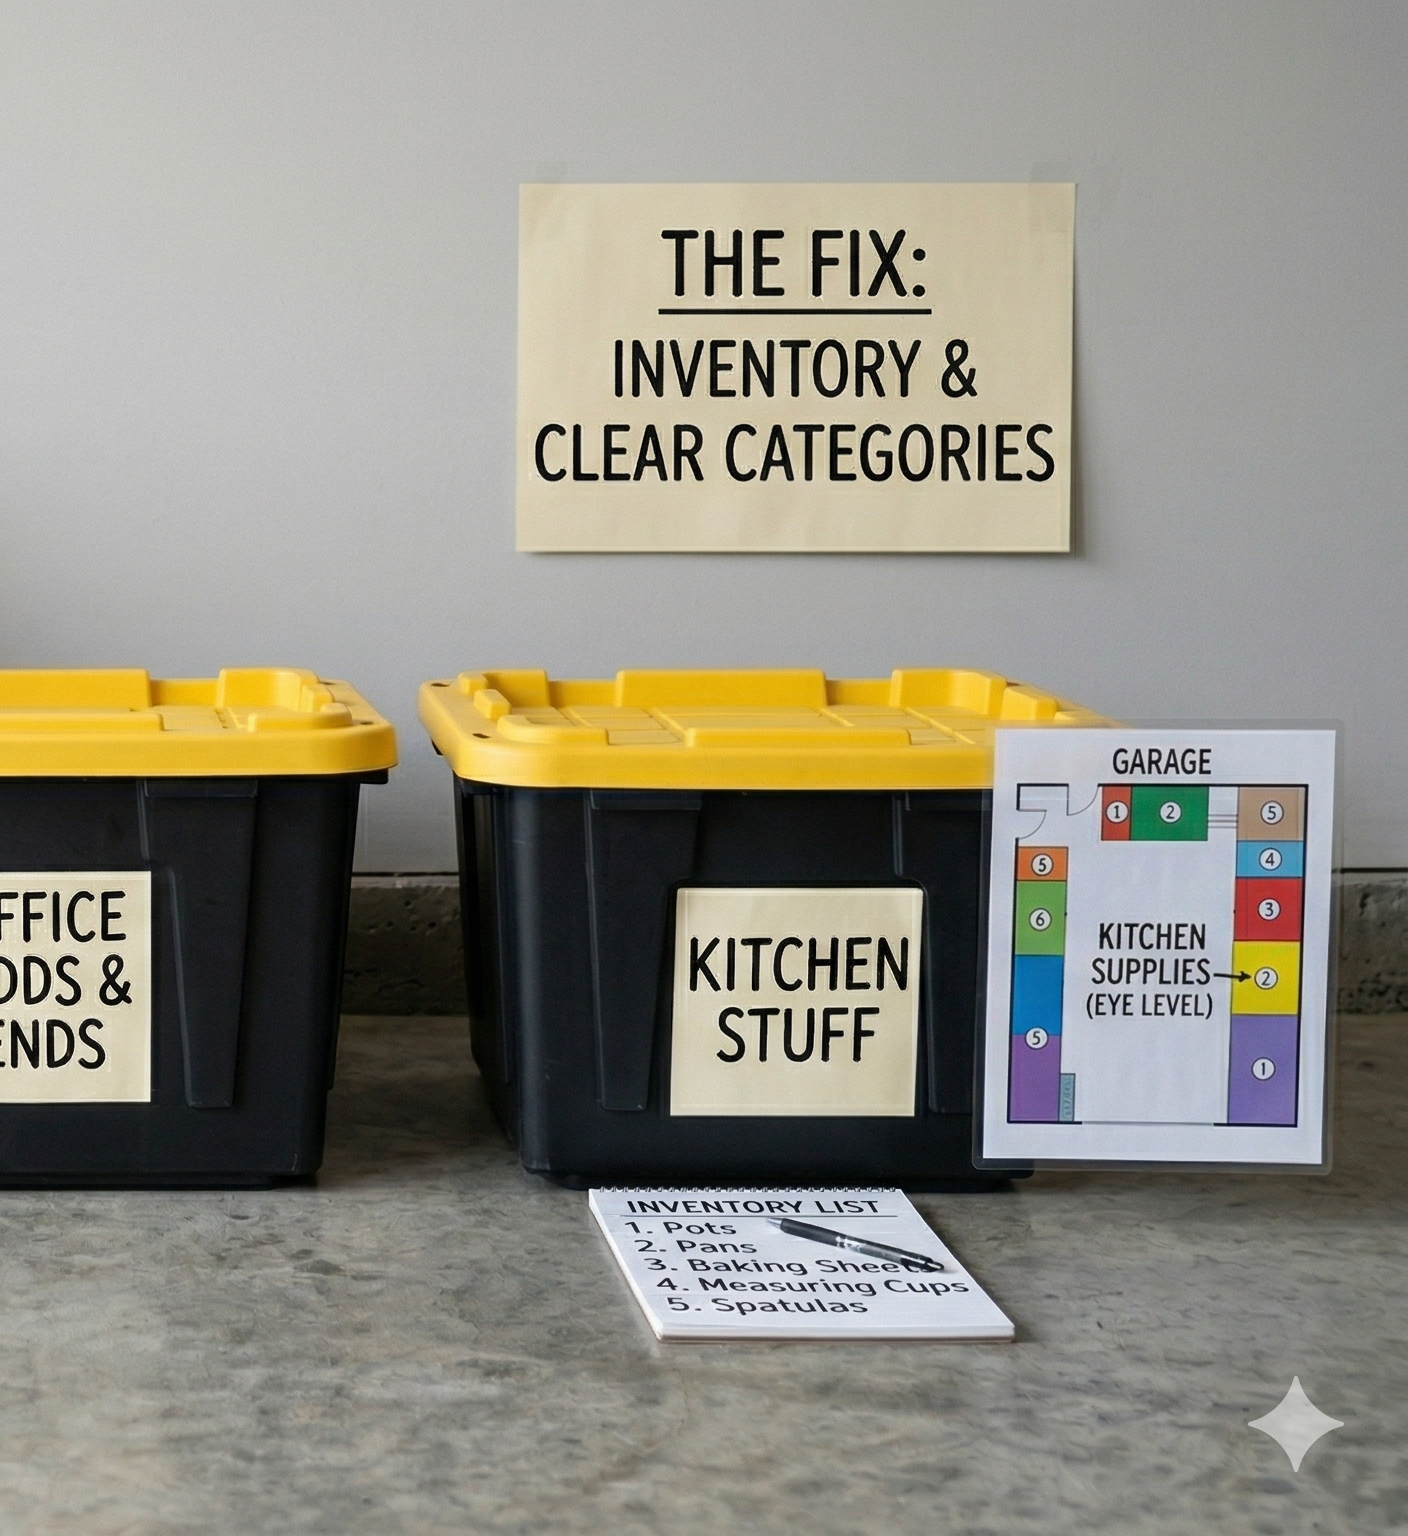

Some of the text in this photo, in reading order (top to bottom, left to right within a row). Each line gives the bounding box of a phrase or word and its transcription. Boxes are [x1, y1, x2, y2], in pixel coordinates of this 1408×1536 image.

[660, 229, 926, 298] THE FIX:
[614, 338, 978, 399] INVENTORY &
[534, 423, 1055, 483] CLEAR CATEGORIES
[1112, 747, 1212, 775] GARAGE
[1112, 803, 1122, 820] 1
[1164, 803, 1176, 821] 2
[1266, 804, 1278, 822] 5
[1037, 856, 1048, 874] 5
[1264, 851, 1276, 868] 4
[1263, 900, 1275, 918] 3
[1034, 910, 1046, 928] 6
[1099, 922, 1206, 951] KITCHEN
[689, 936, 909, 992] KITCHEN
[1091, 957, 1211, 986] SUPPLIES
[98, 953, 133, 1007] &
[1260, 969, 1272, 988] 2
[1086, 992, 1213, 1020] (EYE LEVEL)
[716, 1006, 880, 1063] STUFF
[1031, 1029, 1042, 1047] 5
[1259, 1061, 1268, 1077] 1
[626, 1200, 879, 1214] INVENTORY LIST
[624, 1221, 737, 1235] 1. Pots
[634, 1239, 758, 1254] 2. Pans
[643, 1257, 938, 1276] 3. Baking Sheet
[656, 1277, 969, 1297] 4. Measuring Cups
[666, 1297, 868, 1316] 5. Spatulas
